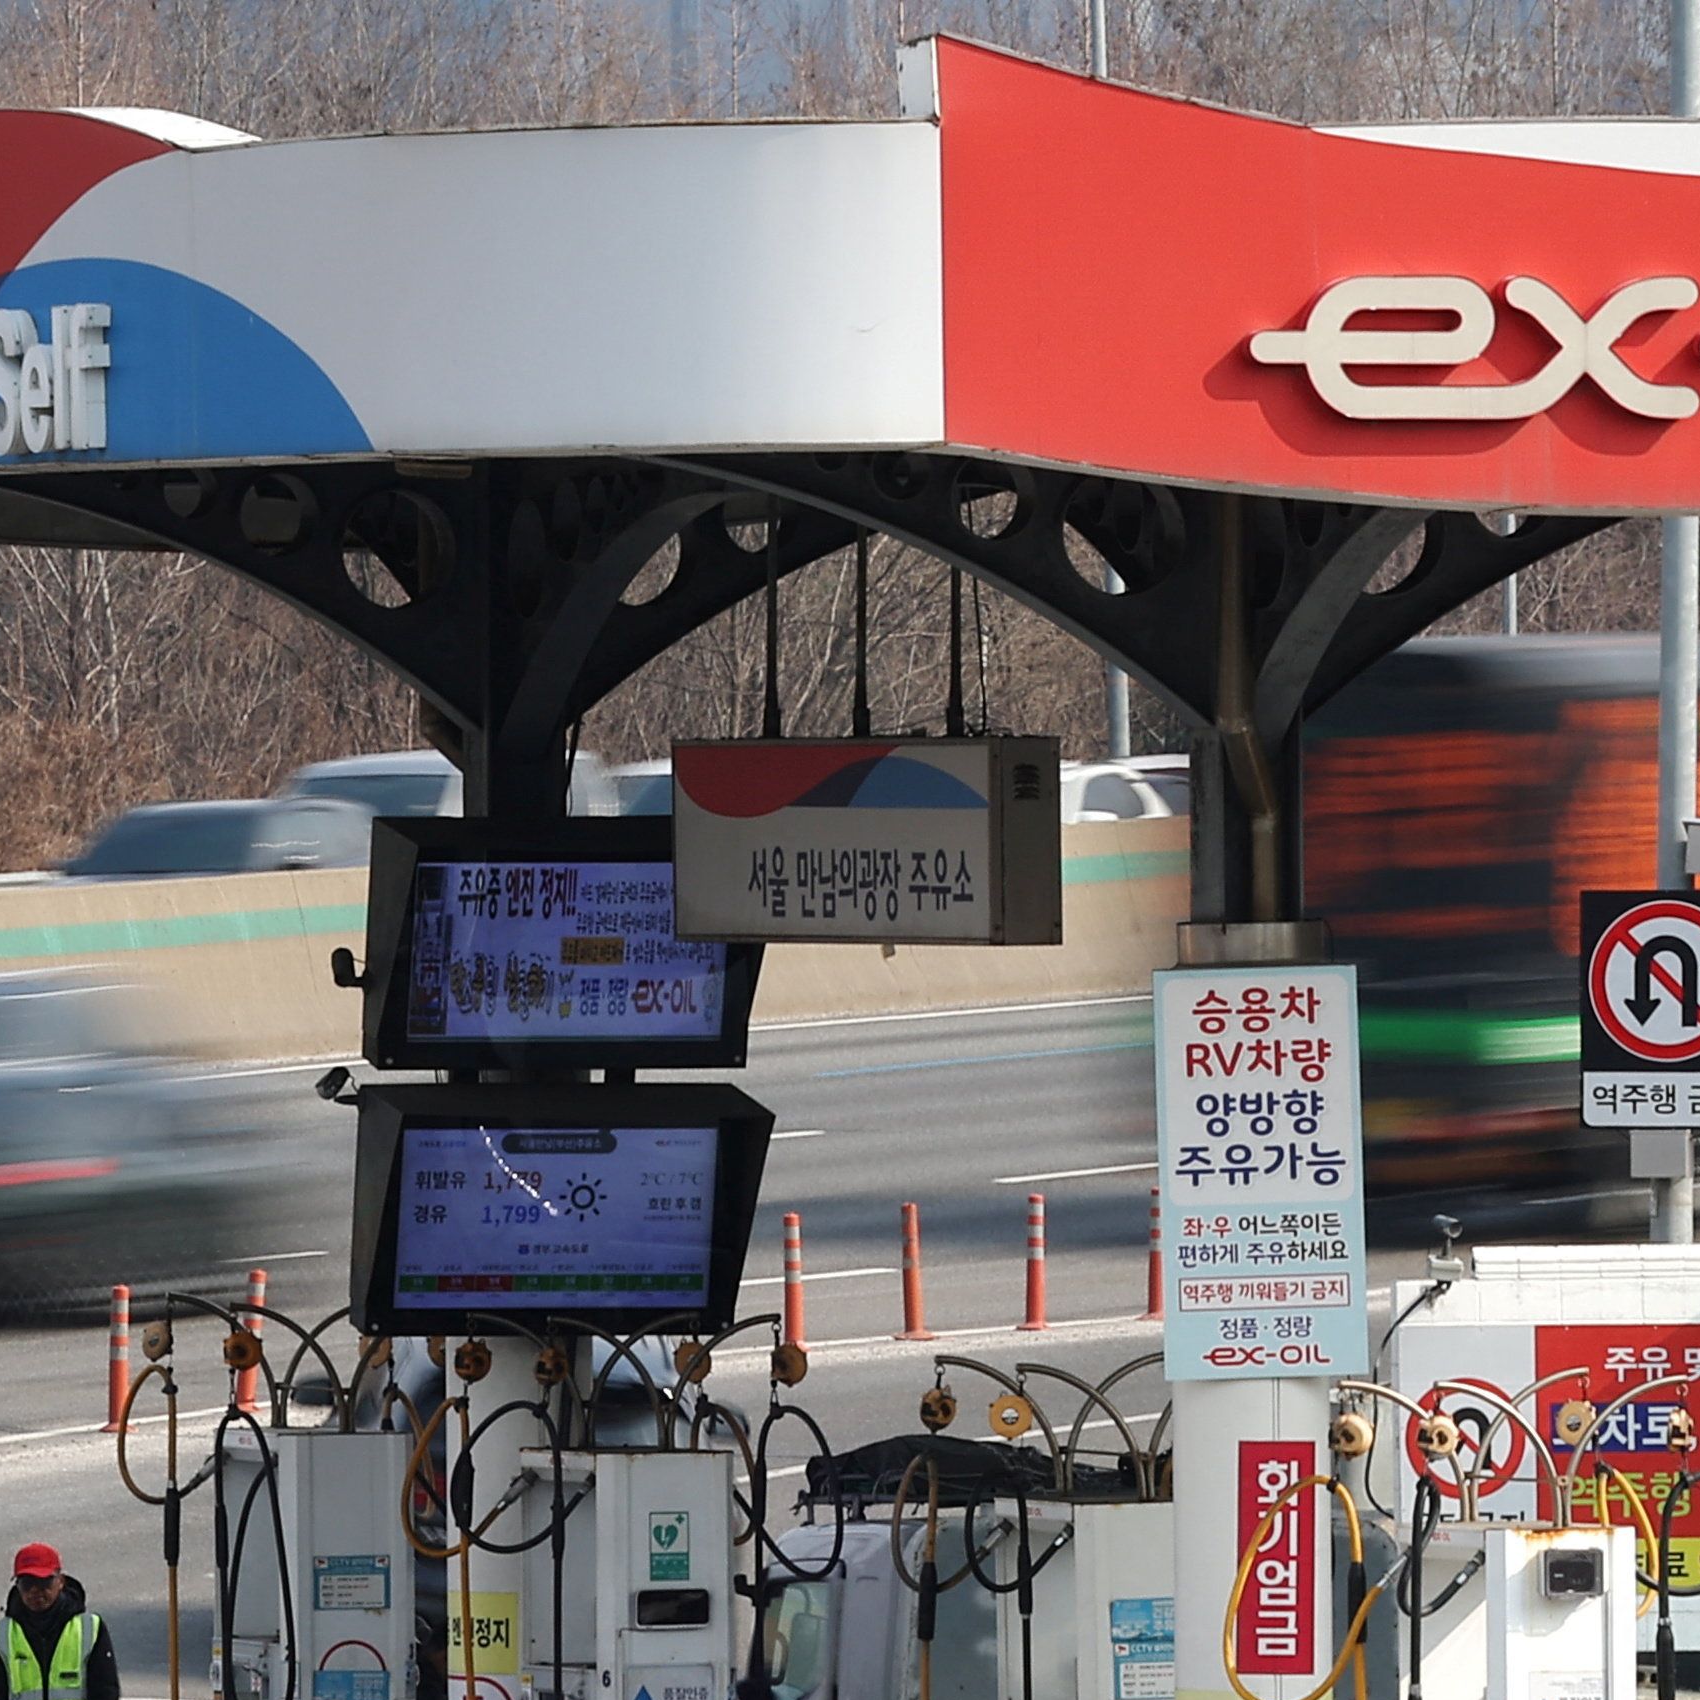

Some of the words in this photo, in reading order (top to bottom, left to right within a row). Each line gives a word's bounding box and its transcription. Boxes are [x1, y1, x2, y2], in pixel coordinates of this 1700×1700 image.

[458, 868, 500, 919] 주유중
[505, 867, 534, 917] 엔진
[539, 868, 578, 919] 정지!!
[748, 846, 789, 918] 서울
[797, 847, 901, 922] 만남의광장
[908, 848, 974, 911] 주유소
[631, 979, 697, 1014] ex-OIL
[1192, 986, 1321, 1034] 승용차
[1186, 1038, 1331, 1082] RV차량
[1196, 1089, 1324, 1137] 양방향
[1593, 1084, 1676, 1115] 역주행
[415, 1171, 467, 1190] 휘발유
[1175, 1142, 1346, 1187] 주유가능
[413, 1205, 447, 1224] 경유
[481, 1204, 540, 1225] 1,799
[1183, 1216, 1232, 1238] 좌·우
[1238, 1212, 1342, 1237] 어느쪽이든
[1178, 1244, 1239, 1269] 편하게
[1246, 1240, 1349, 1265] 주유하세요
[1184, 1283, 1233, 1303] 역주행
[1239, 1281, 1305, 1300] 끼워들기
[1311, 1280, 1344, 1300] 금지
[1220, 1317, 1259, 1340] 정품
[1274, 1316, 1313, 1338] 정량
[1203, 1344, 1331, 1367] ex-OIL
[1604, 1345, 1671, 1382] 주유
[1552, 1403, 1697, 1453] 차로,
[1571, 1474, 1693, 1519] 역주행
[1256, 1460, 1299, 1656] 화기엄금
[602, 1670, 611, 1687] 6
